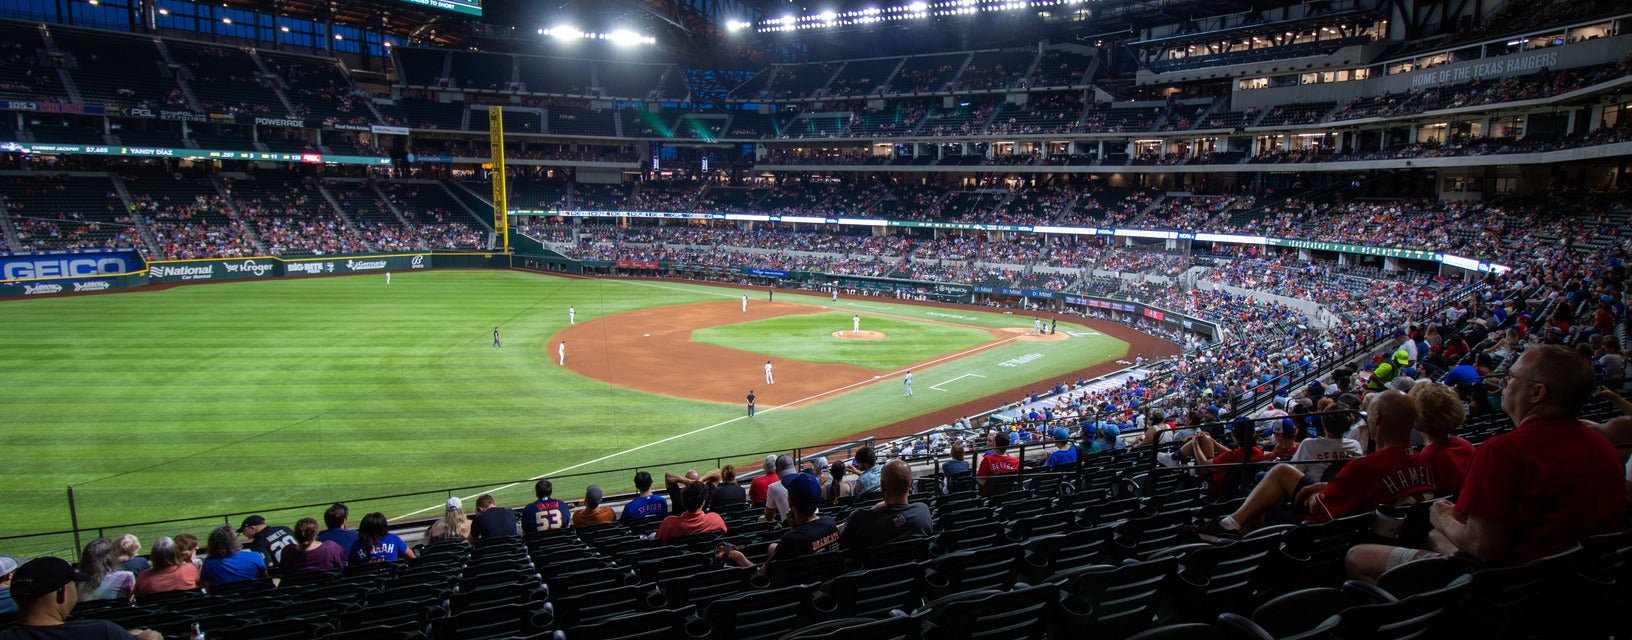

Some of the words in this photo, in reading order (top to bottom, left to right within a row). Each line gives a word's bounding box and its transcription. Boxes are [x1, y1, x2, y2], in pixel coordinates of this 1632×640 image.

[438, 2, 456, 10] SHORT
[1412, 72, 1437, 87] HOME
[1439, 69, 1451, 83] OF
[1453, 66, 1471, 80] THE
[1473, 61, 1504, 78] TEXAS
[1506, 52, 1558, 72] RANGERS
[8, 101, 37, 110] 105.3
[131, 108, 156, 118] PGL
[255, 117, 304, 128] POWERADE
[129, 148, 154, 156] YANDY
[3, 258, 126, 281] GEICO
[164, 264, 213, 277] National
[240, 259, 274, 276] Kroger
[1038, 291, 1052, 299] Mitel
[638, 502, 662, 515] SEAGER
[535, 509, 563, 532] 53
